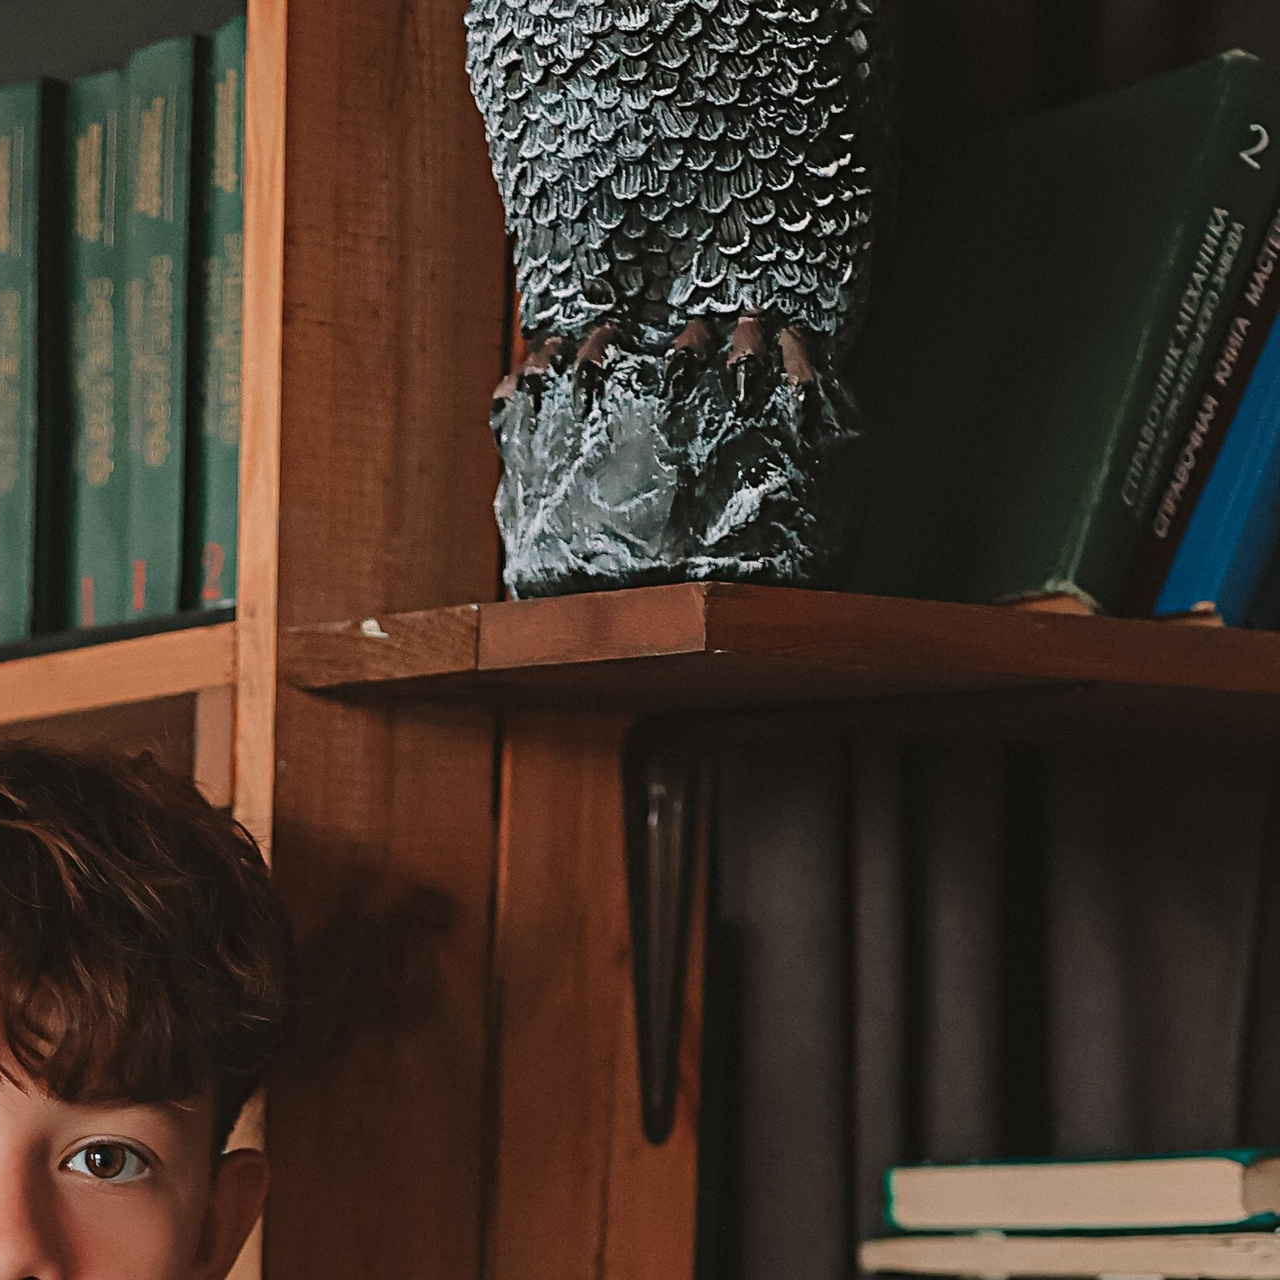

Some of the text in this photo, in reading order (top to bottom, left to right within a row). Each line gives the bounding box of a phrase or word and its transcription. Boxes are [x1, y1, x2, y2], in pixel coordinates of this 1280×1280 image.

[1238, 123, 1270, 170] 2
[1121, 206, 1229, 506] СПРАВОЧНИК МЕХАНИКА
[1152, 392, 1219, 539] СПРАВОЧНАЯ
[1214, 316, 1252, 388] КНИГА
